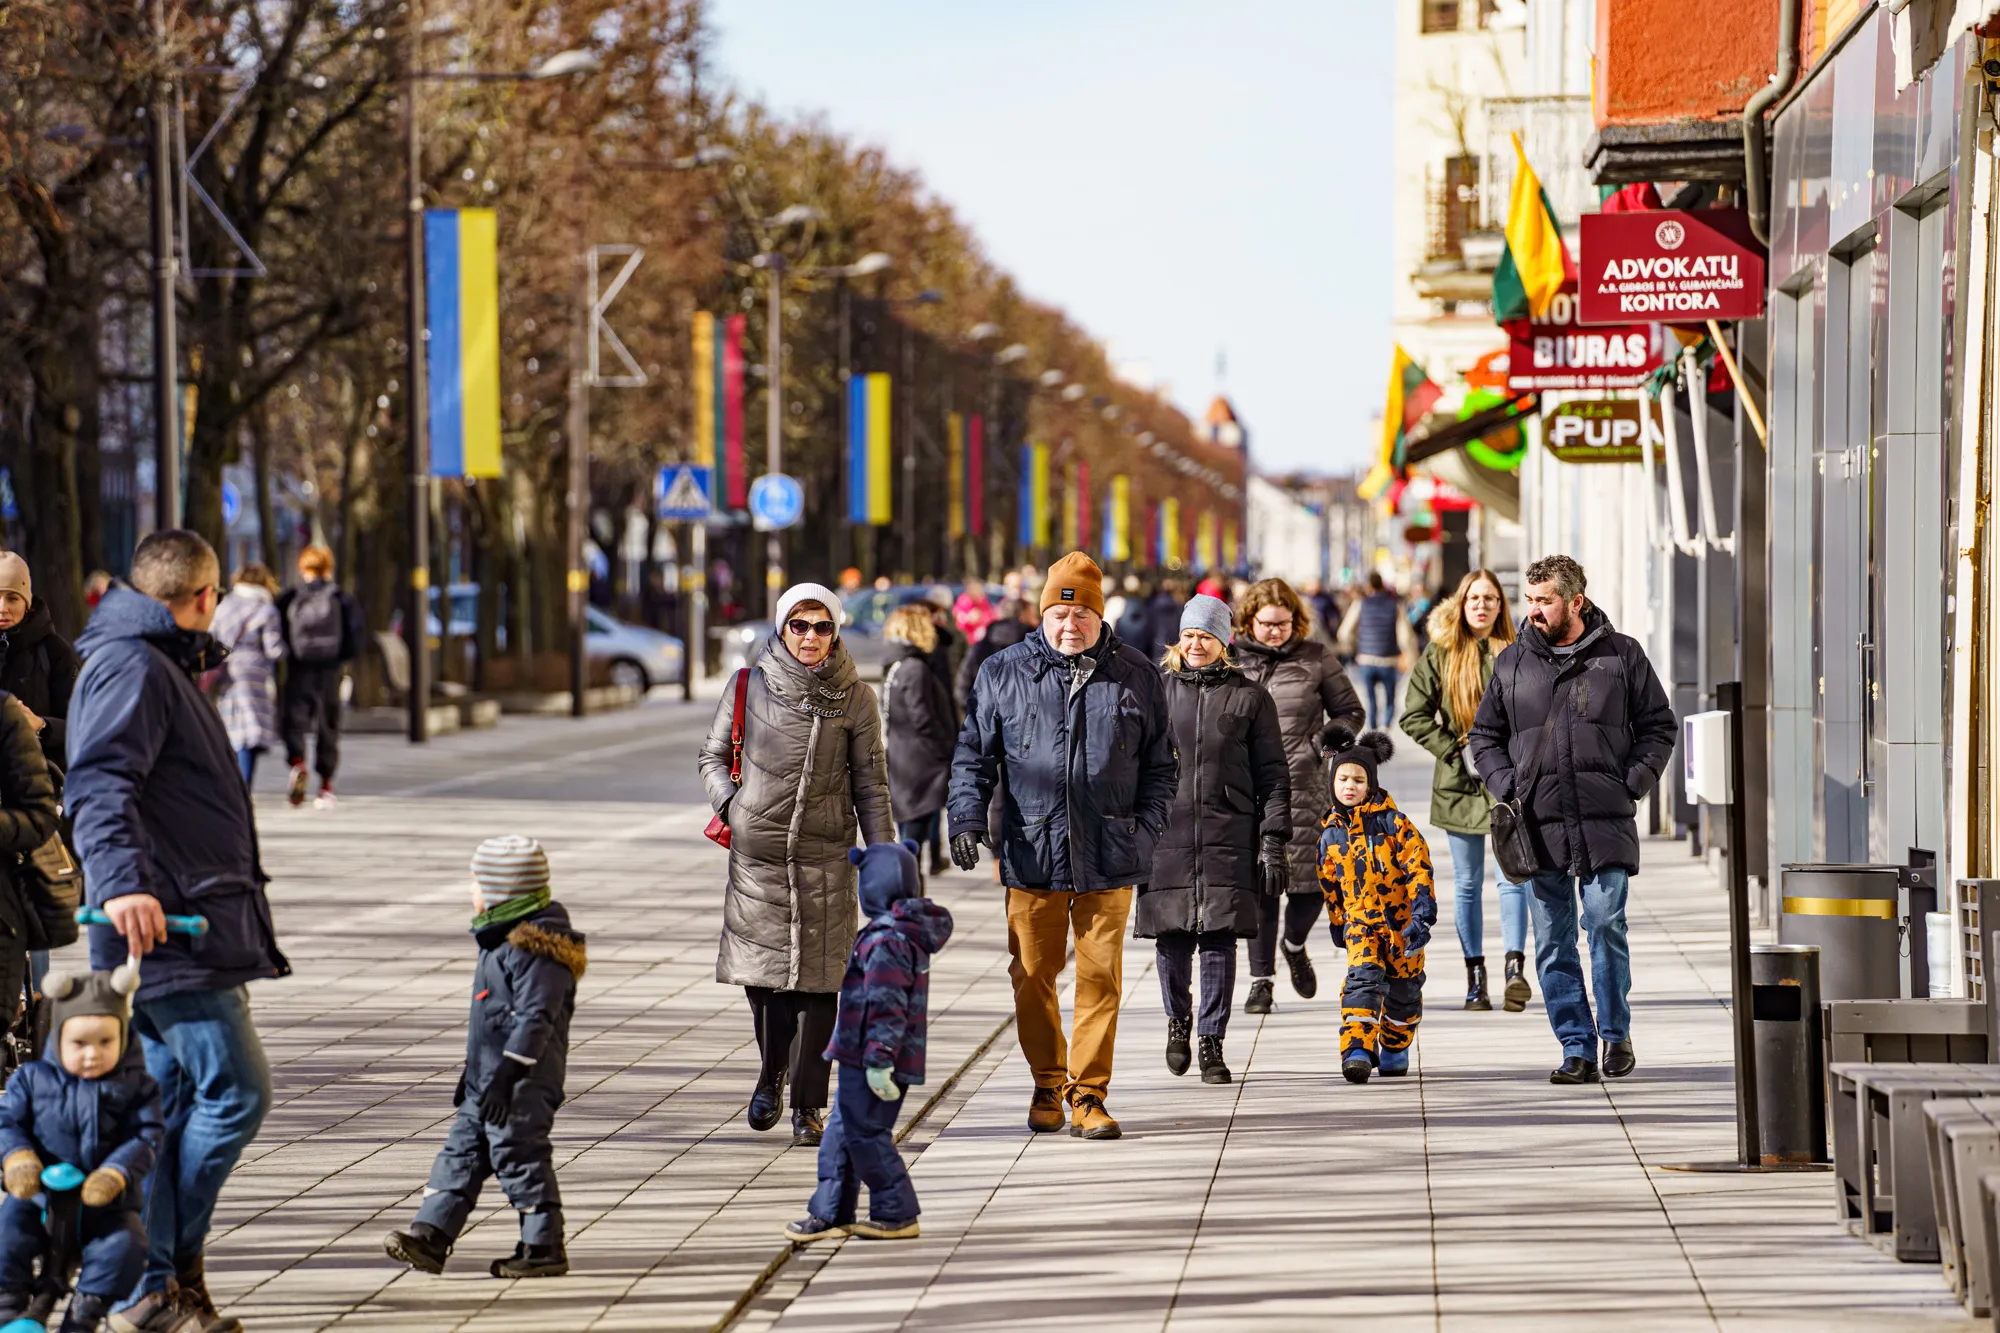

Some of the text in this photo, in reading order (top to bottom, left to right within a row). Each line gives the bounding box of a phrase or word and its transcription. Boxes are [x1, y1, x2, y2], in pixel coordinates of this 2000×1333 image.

[1602, 255, 1738, 280] ADVOKATŲ
[1656, 281, 1667, 292] IR
[1620, 292, 1720, 313] KONTORA
[1533, 333, 1647, 368] BIURAS
